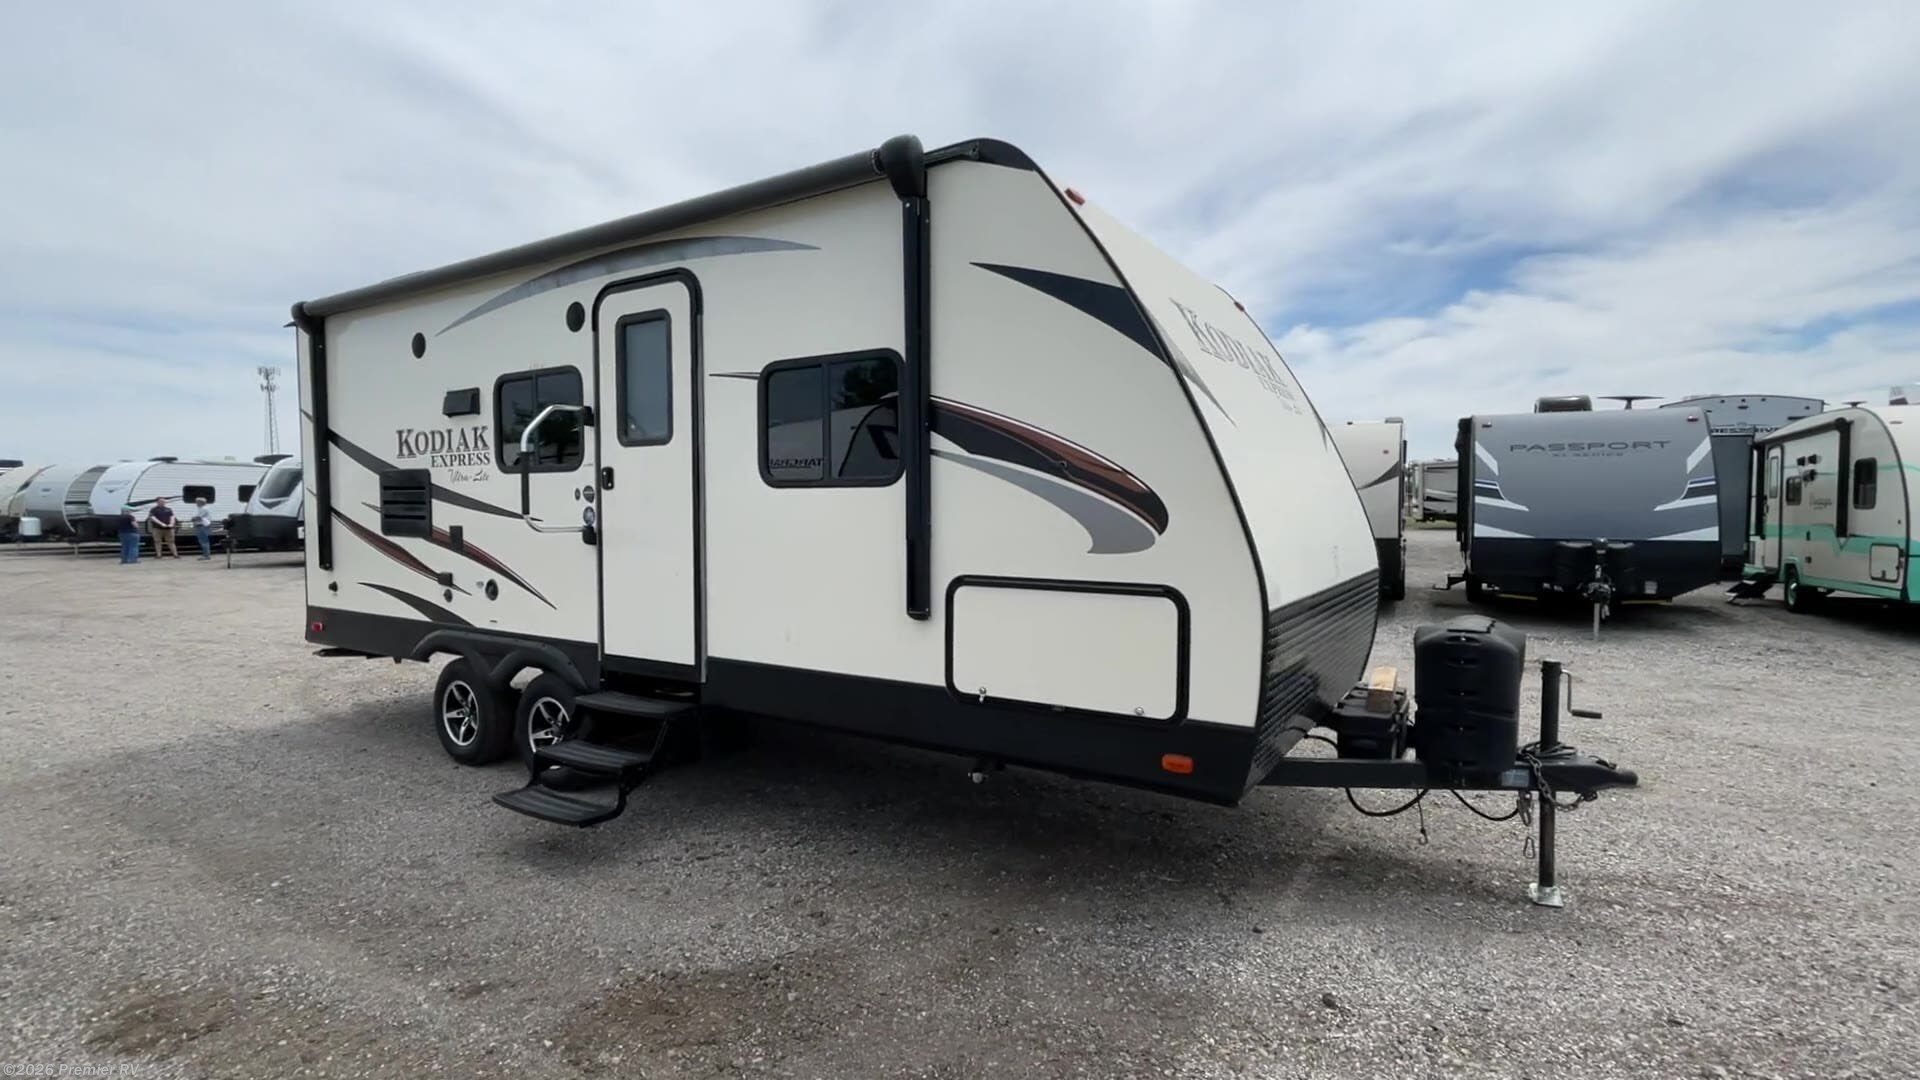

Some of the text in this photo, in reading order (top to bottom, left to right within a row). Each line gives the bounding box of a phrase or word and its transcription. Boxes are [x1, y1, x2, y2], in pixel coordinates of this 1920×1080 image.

[396, 426, 490, 459] KODIAK
[1510, 440, 1671, 452] PASSPORT
[431, 452, 490, 468] EXPRESS
